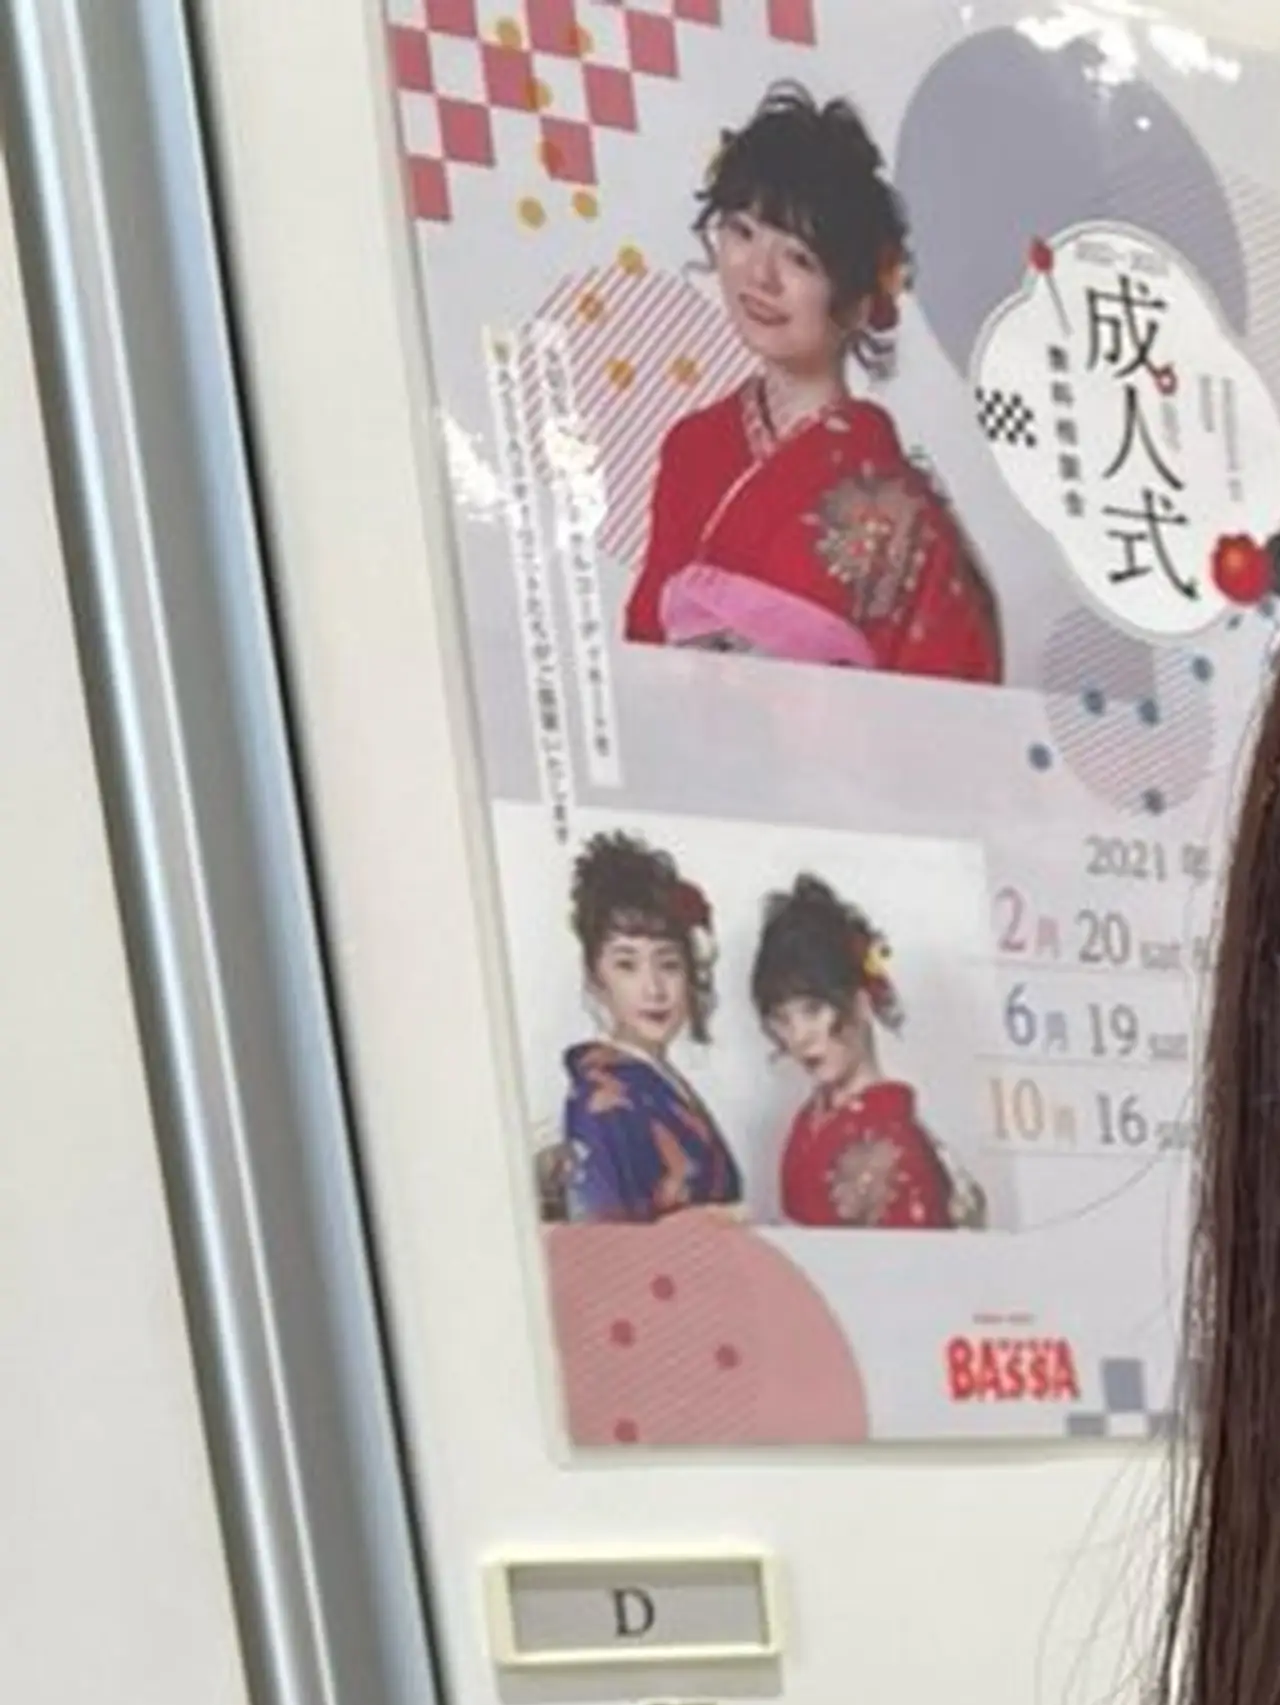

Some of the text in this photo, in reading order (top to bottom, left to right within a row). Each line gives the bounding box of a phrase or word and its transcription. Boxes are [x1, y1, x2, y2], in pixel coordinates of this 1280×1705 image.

[1084, 273, 1199, 600] 成人式
[1075, 909, 1131, 966] 20
[1088, 1003, 1140, 1056] 19
[1096, 1090, 1148, 1146] 16
[946, 1335, 1081, 1402] BASSA
[612, 1587, 655, 1638] D
